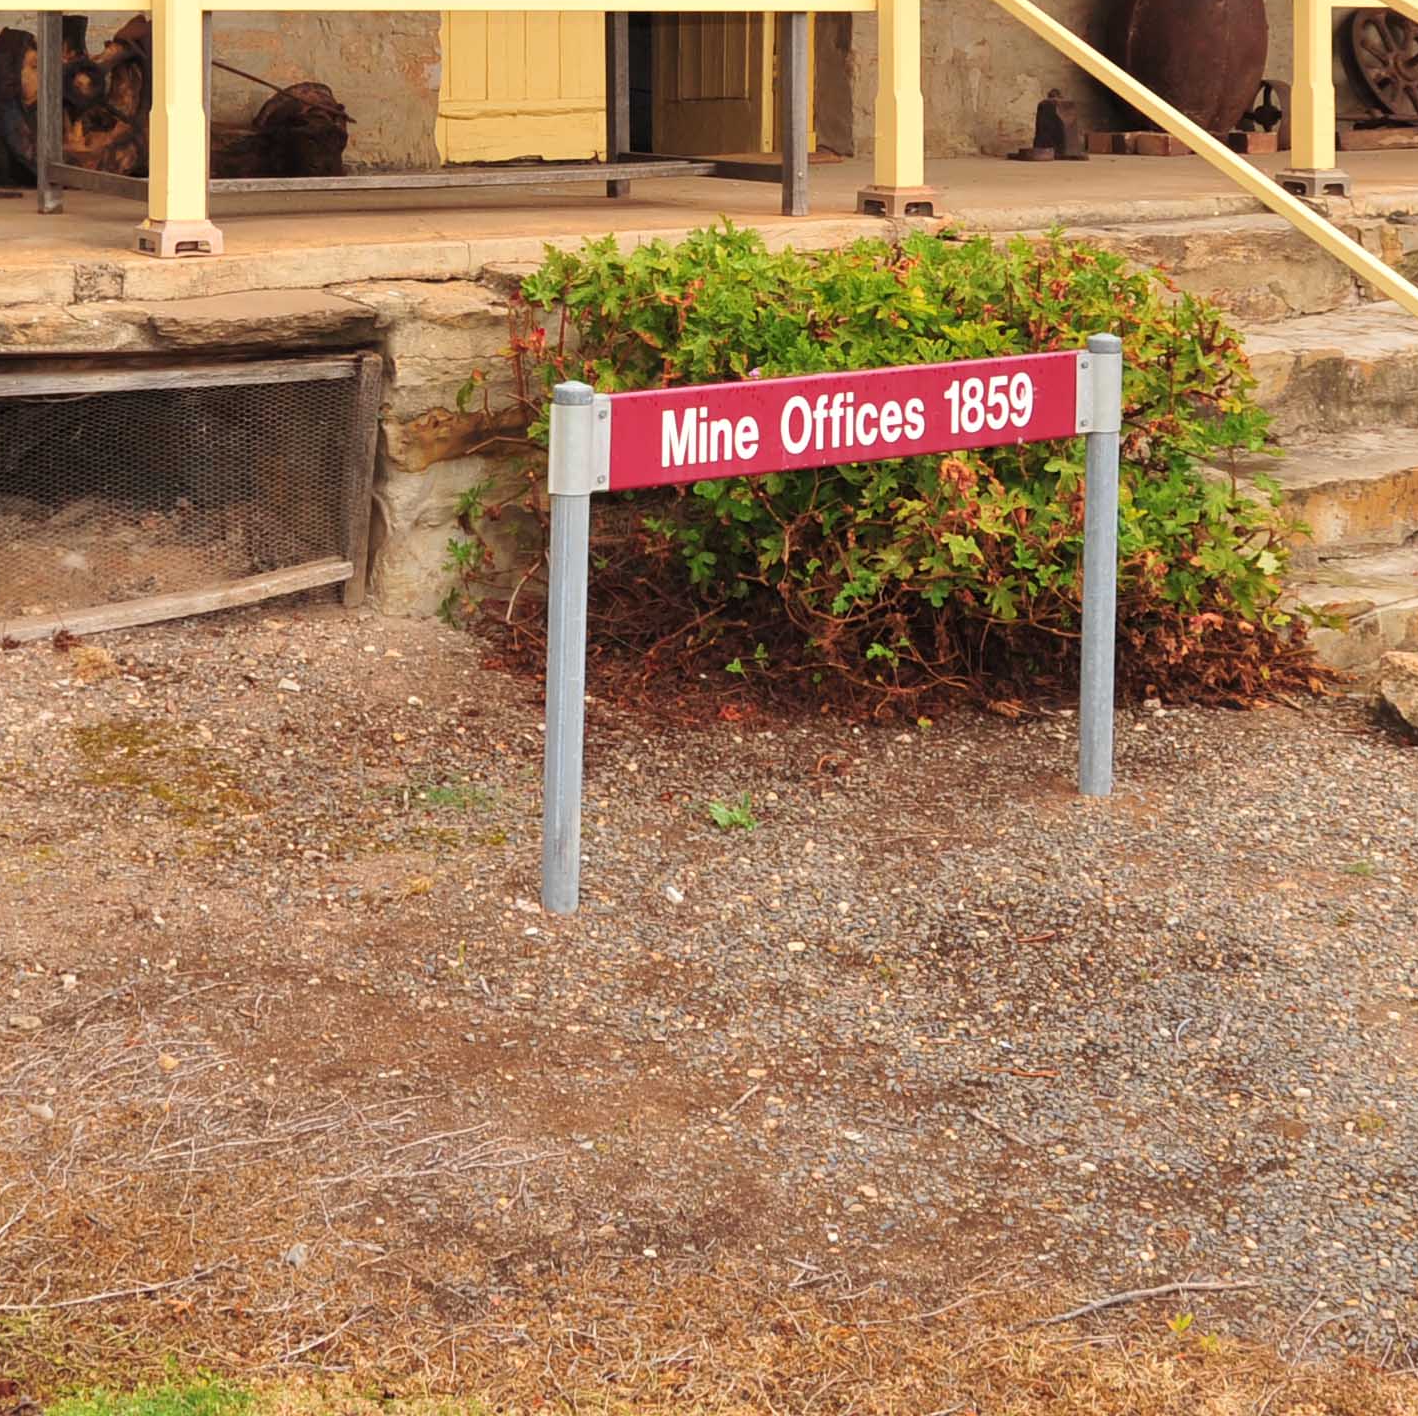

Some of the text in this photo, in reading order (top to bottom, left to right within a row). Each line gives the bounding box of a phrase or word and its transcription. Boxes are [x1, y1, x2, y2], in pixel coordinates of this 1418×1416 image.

[660, 371, 1034, 468] Mine Offices 1859
